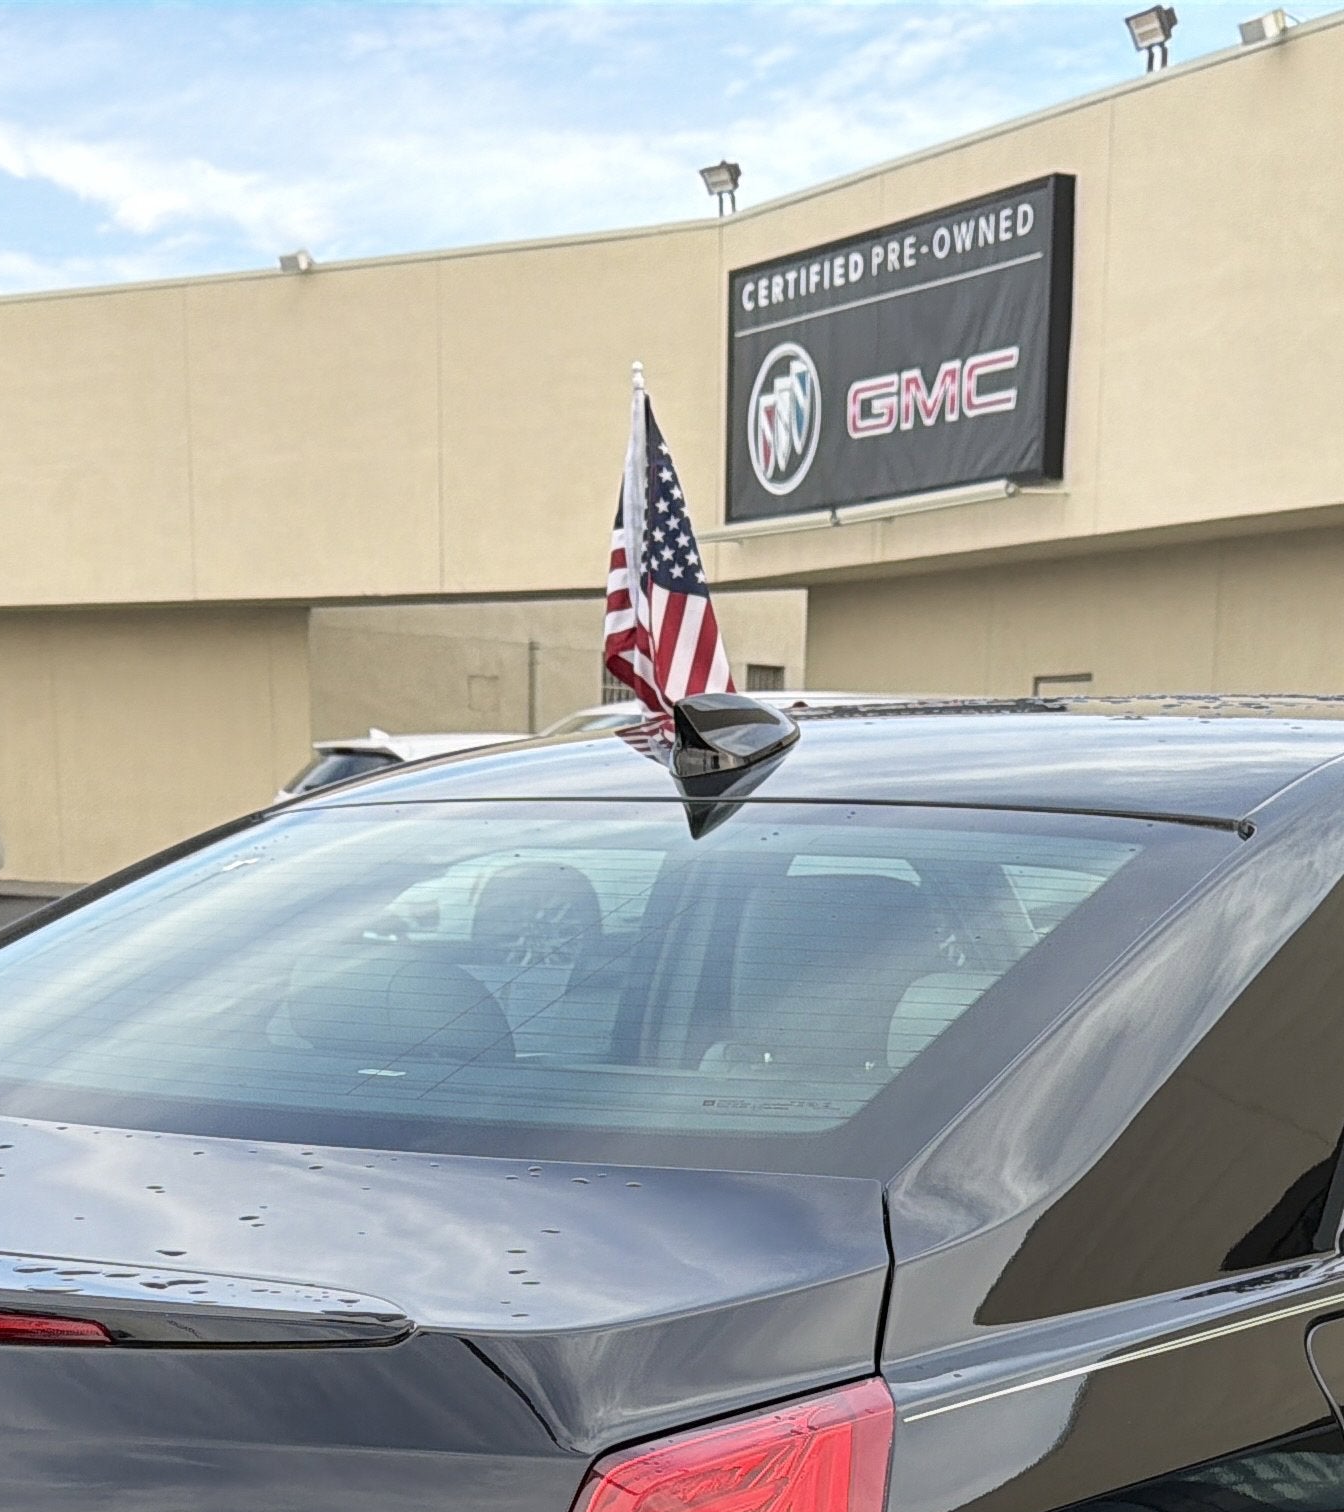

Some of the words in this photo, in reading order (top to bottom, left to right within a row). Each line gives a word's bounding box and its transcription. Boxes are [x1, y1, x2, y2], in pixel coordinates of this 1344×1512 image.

[742, 252, 863, 311] CERTIFIED
[871, 203, 1035, 276] PRE-OWNED
[847, 346, 1020, 438] GMC
